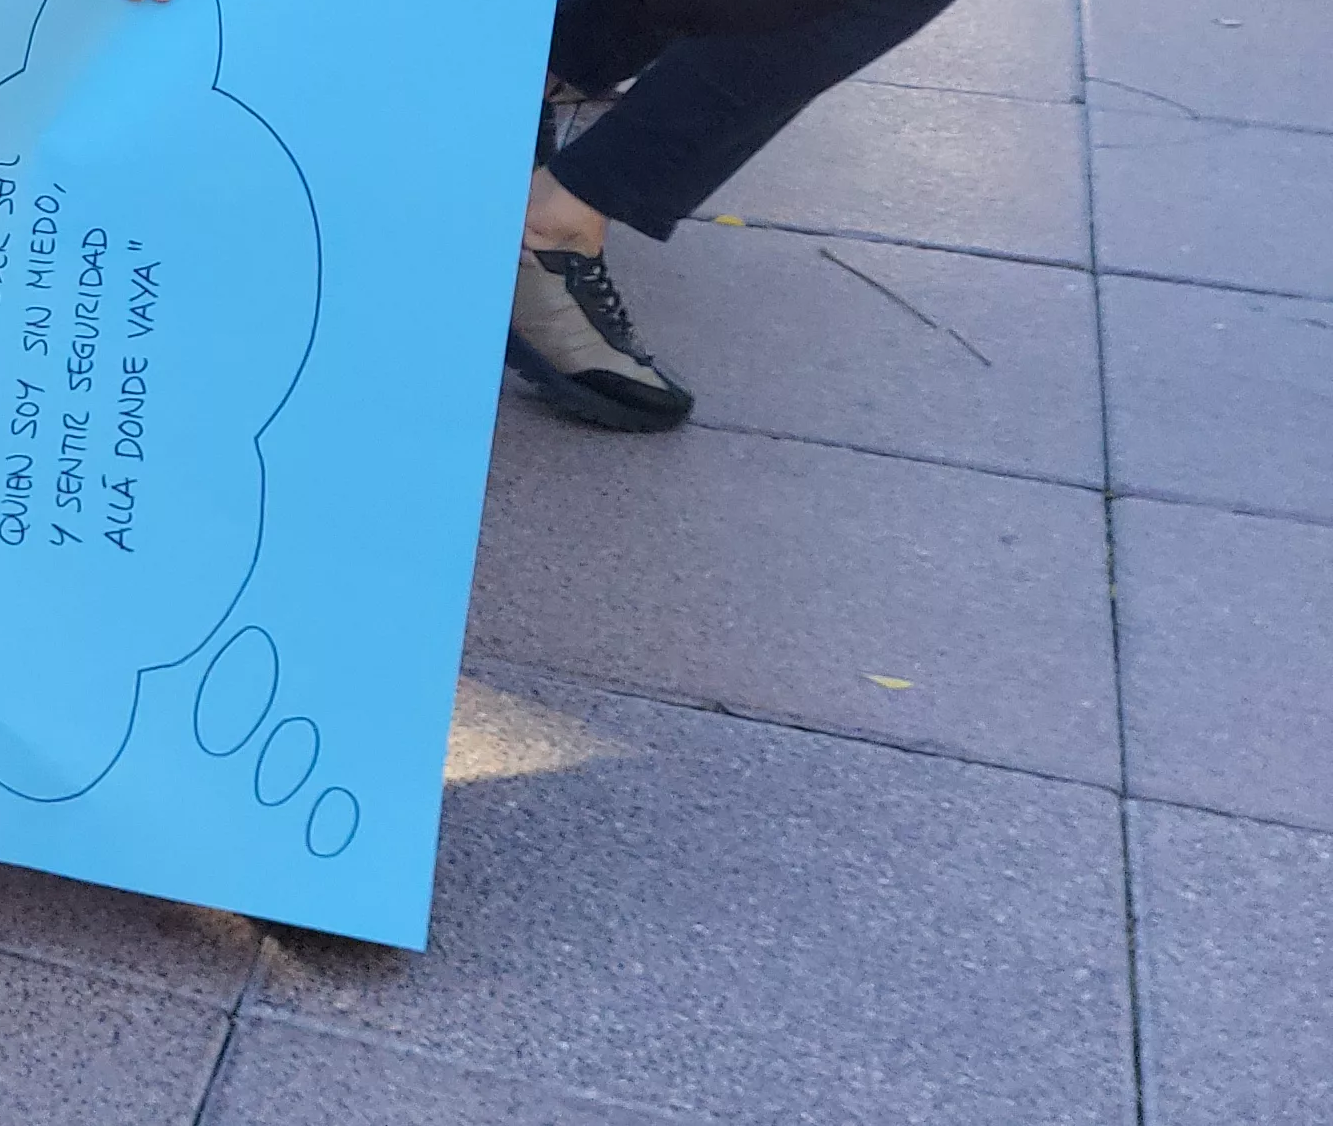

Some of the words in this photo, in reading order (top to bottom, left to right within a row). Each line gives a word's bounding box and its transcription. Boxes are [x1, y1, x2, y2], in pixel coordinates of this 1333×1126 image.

[25, 182, 68, 290] MIEDO,
[23, 306, 53, 357] SIN
[67, 227, 109, 393] SEGURIDAD
[10, 378, 46, 440] SOY
[114, 356, 149, 462] DONDE
[55, 410, 91, 514] SENTIR
[49, 522, 84, 547] Y
[102, 473, 139, 553] ALLÁ
